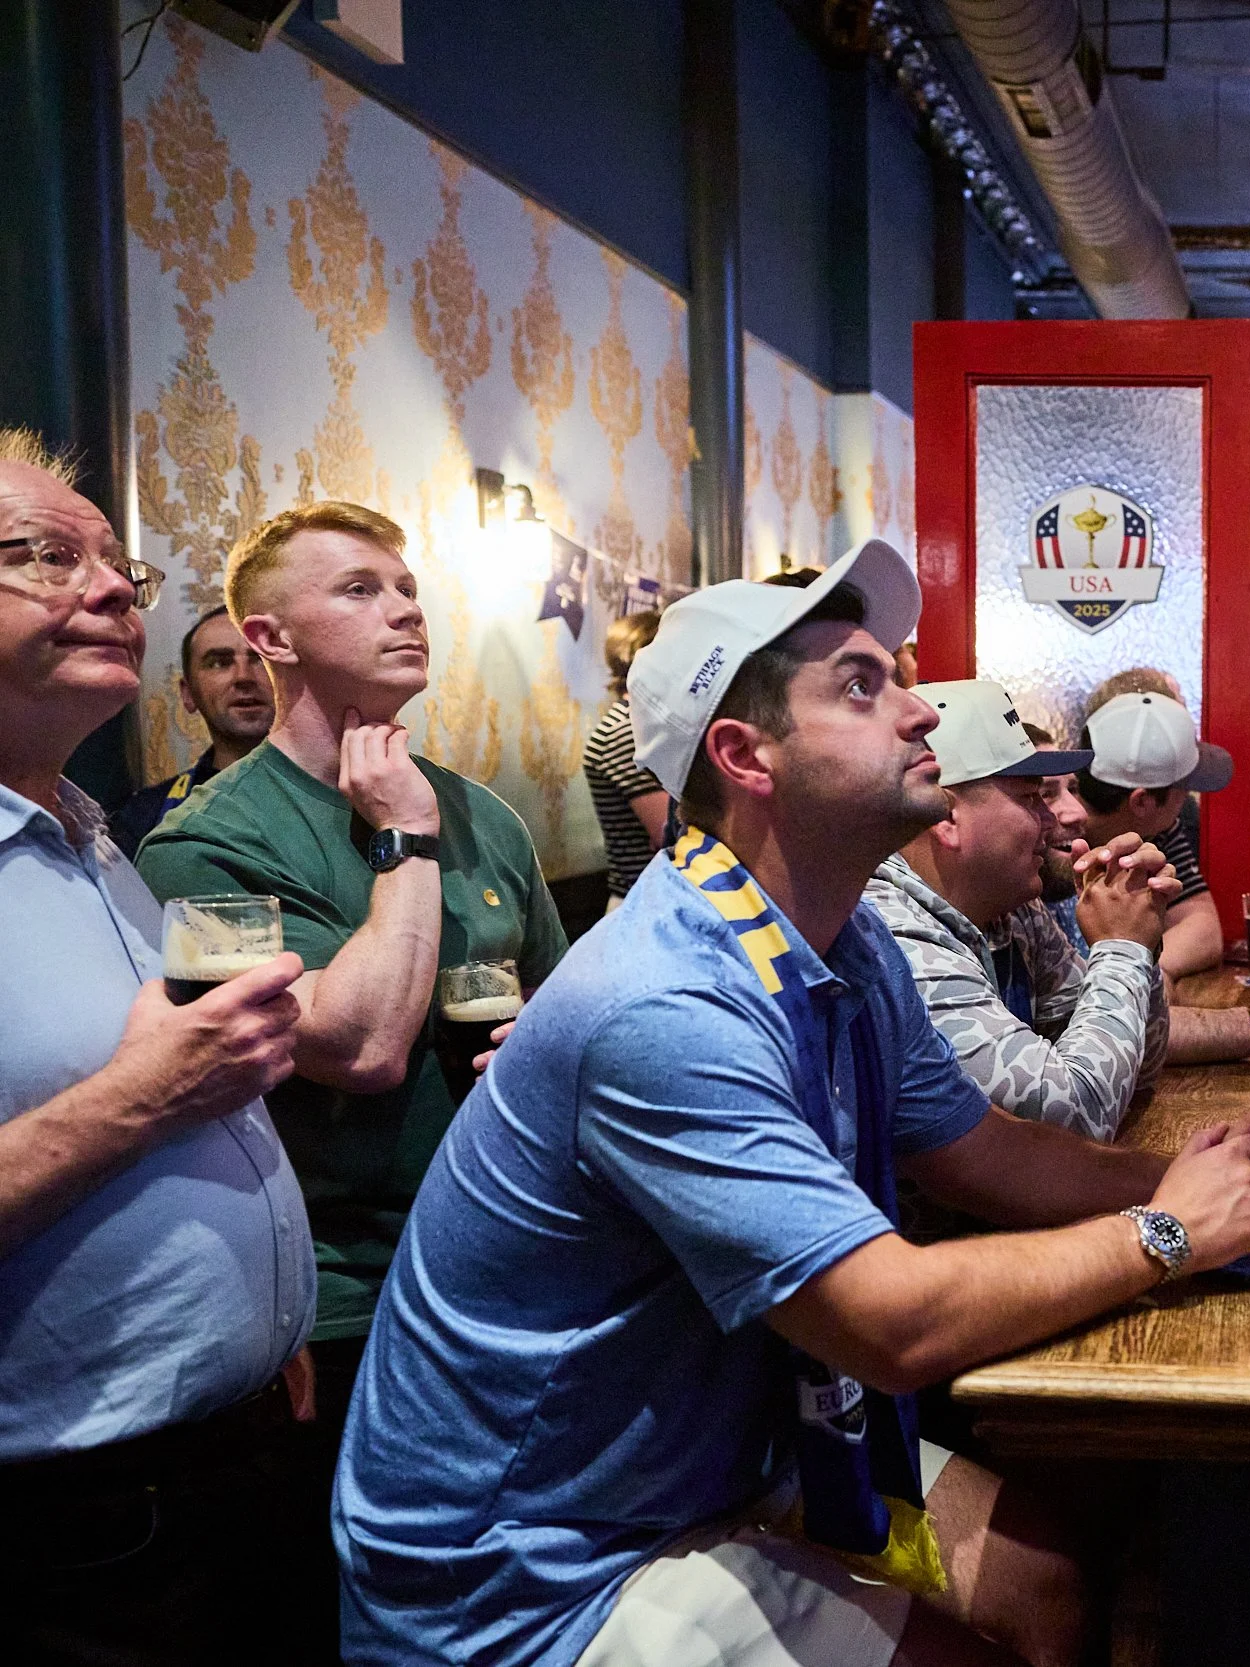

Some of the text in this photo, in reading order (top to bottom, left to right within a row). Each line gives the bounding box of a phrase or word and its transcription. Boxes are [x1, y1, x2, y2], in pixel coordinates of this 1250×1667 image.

[1069, 576, 1113, 593] USA
[1073, 604, 1111, 616] 2025
[689, 645, 724, 695] BETHPAGE
[701, 659, 725, 690] BLACK
